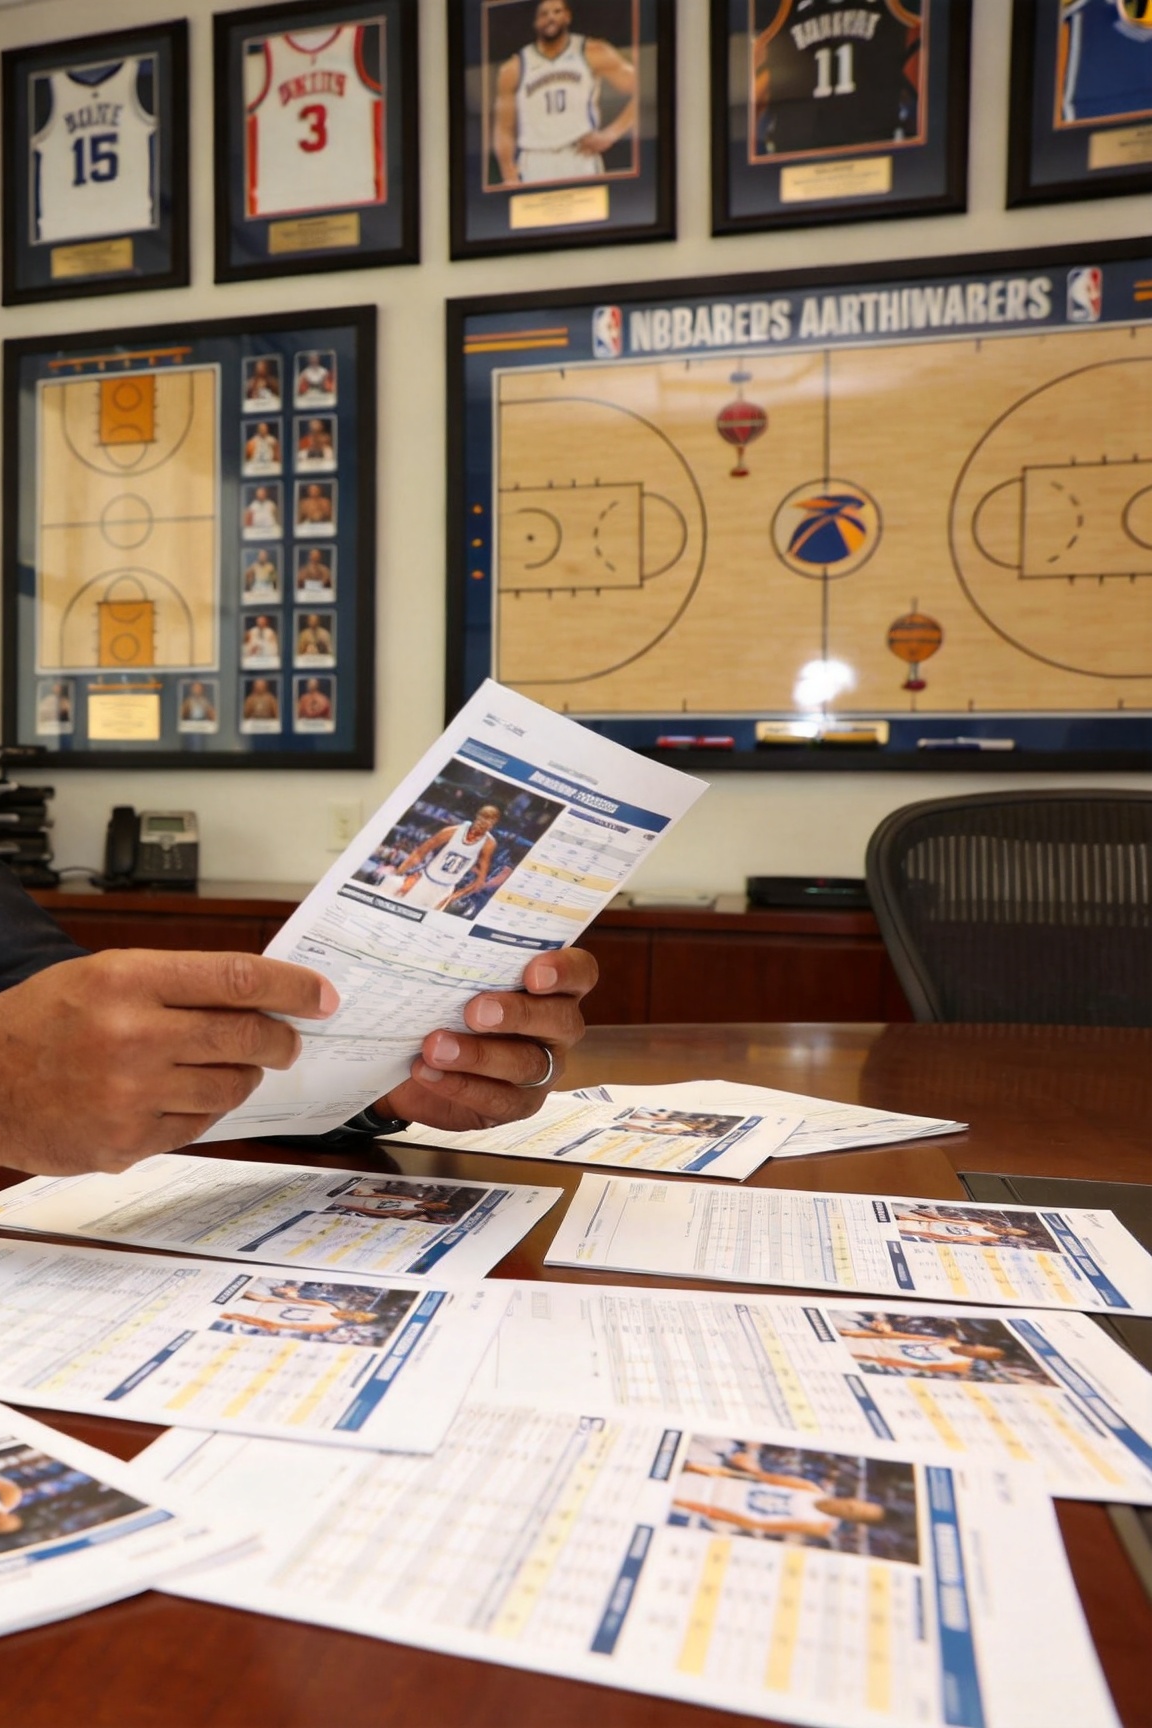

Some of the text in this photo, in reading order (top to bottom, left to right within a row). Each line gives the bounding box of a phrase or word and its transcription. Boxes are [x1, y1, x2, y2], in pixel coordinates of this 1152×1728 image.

[813, 43, 855, 98] 11
[298, 103, 327, 153] 3
[73, 132, 118, 187] 15
